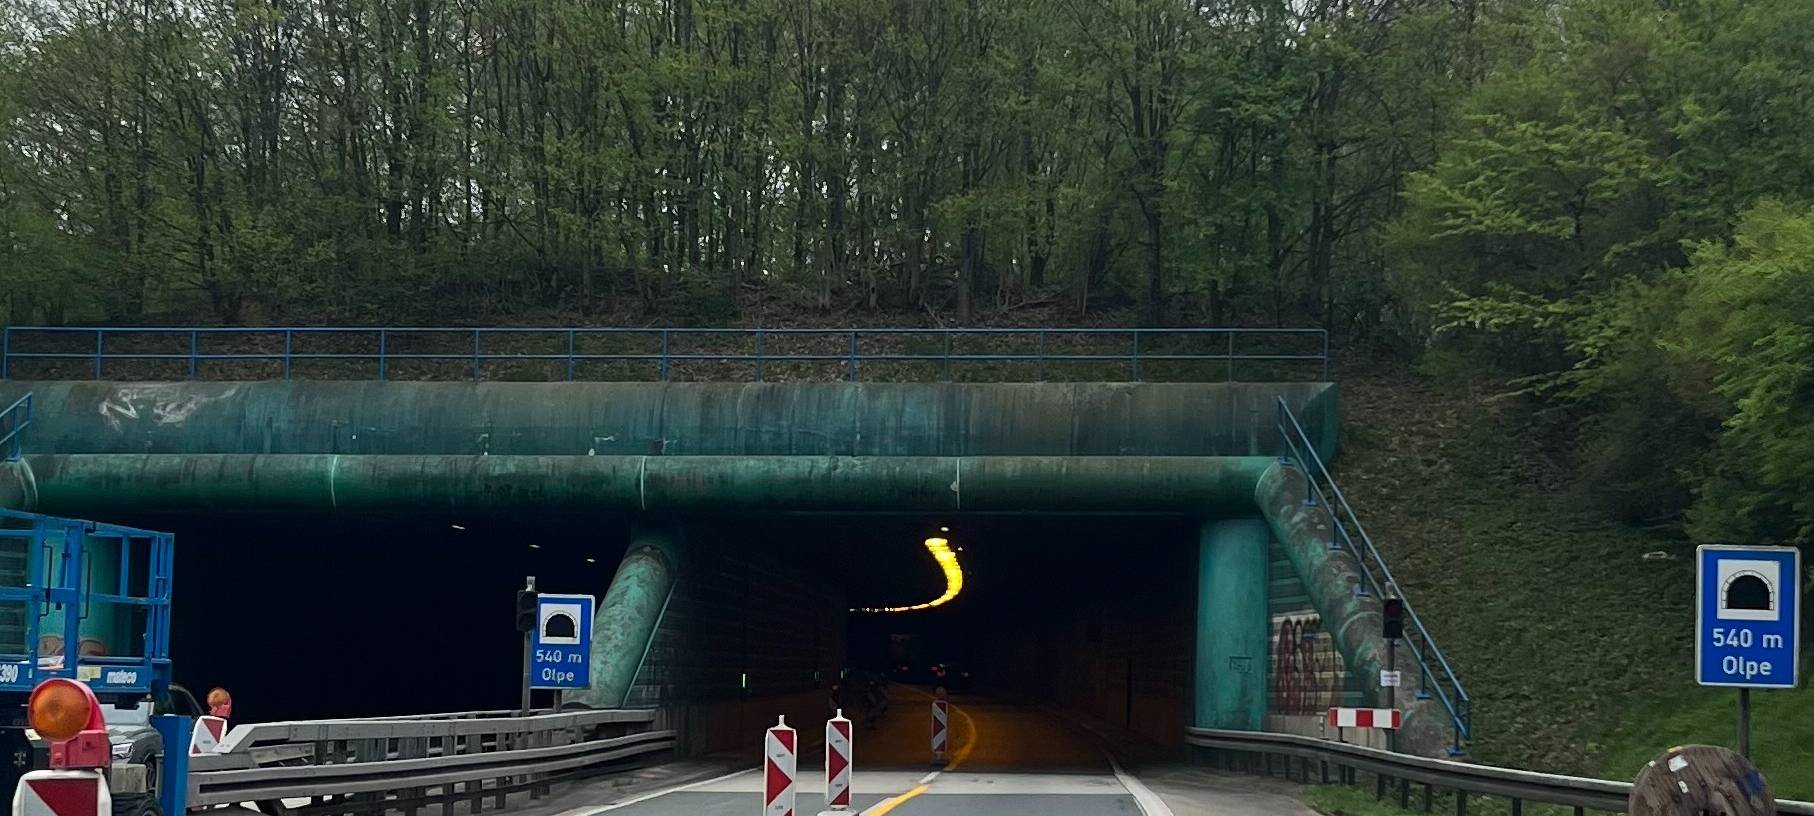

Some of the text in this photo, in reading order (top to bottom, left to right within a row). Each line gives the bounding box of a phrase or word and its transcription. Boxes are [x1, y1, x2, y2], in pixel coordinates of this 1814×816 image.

[1712, 628, 1783, 648] 540 m
[536, 650, 582, 663] 540 m
[0, 664, 19, 683] 390
[542, 668, 575, 684] Olpe
[1722, 655, 1772, 680] Olpe
